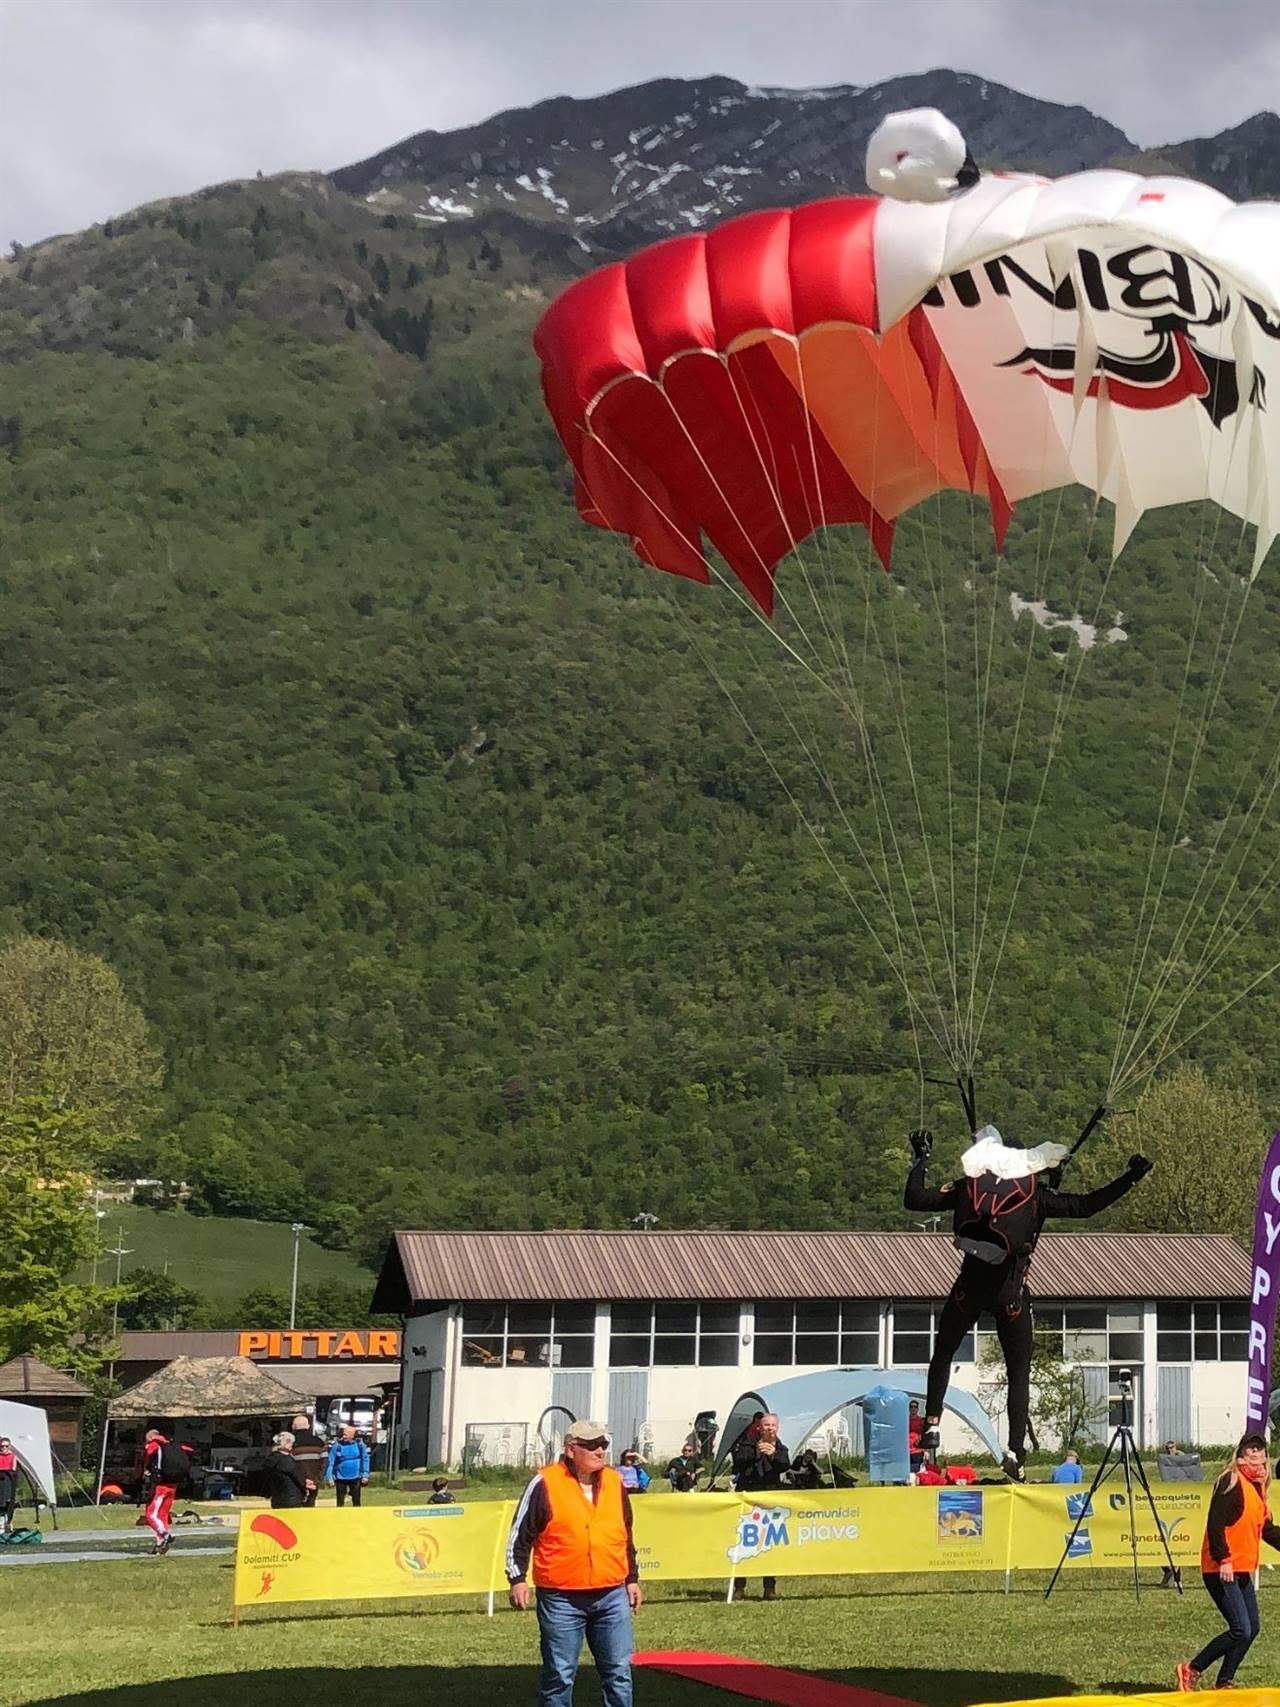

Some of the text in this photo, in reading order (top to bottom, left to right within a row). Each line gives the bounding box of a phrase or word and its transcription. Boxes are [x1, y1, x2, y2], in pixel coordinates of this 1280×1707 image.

[239, 1331, 397, 1357] PITTAR
[797, 1521, 859, 1544] piave
[243, 1553, 301, 1565] Dolomiti CUP
